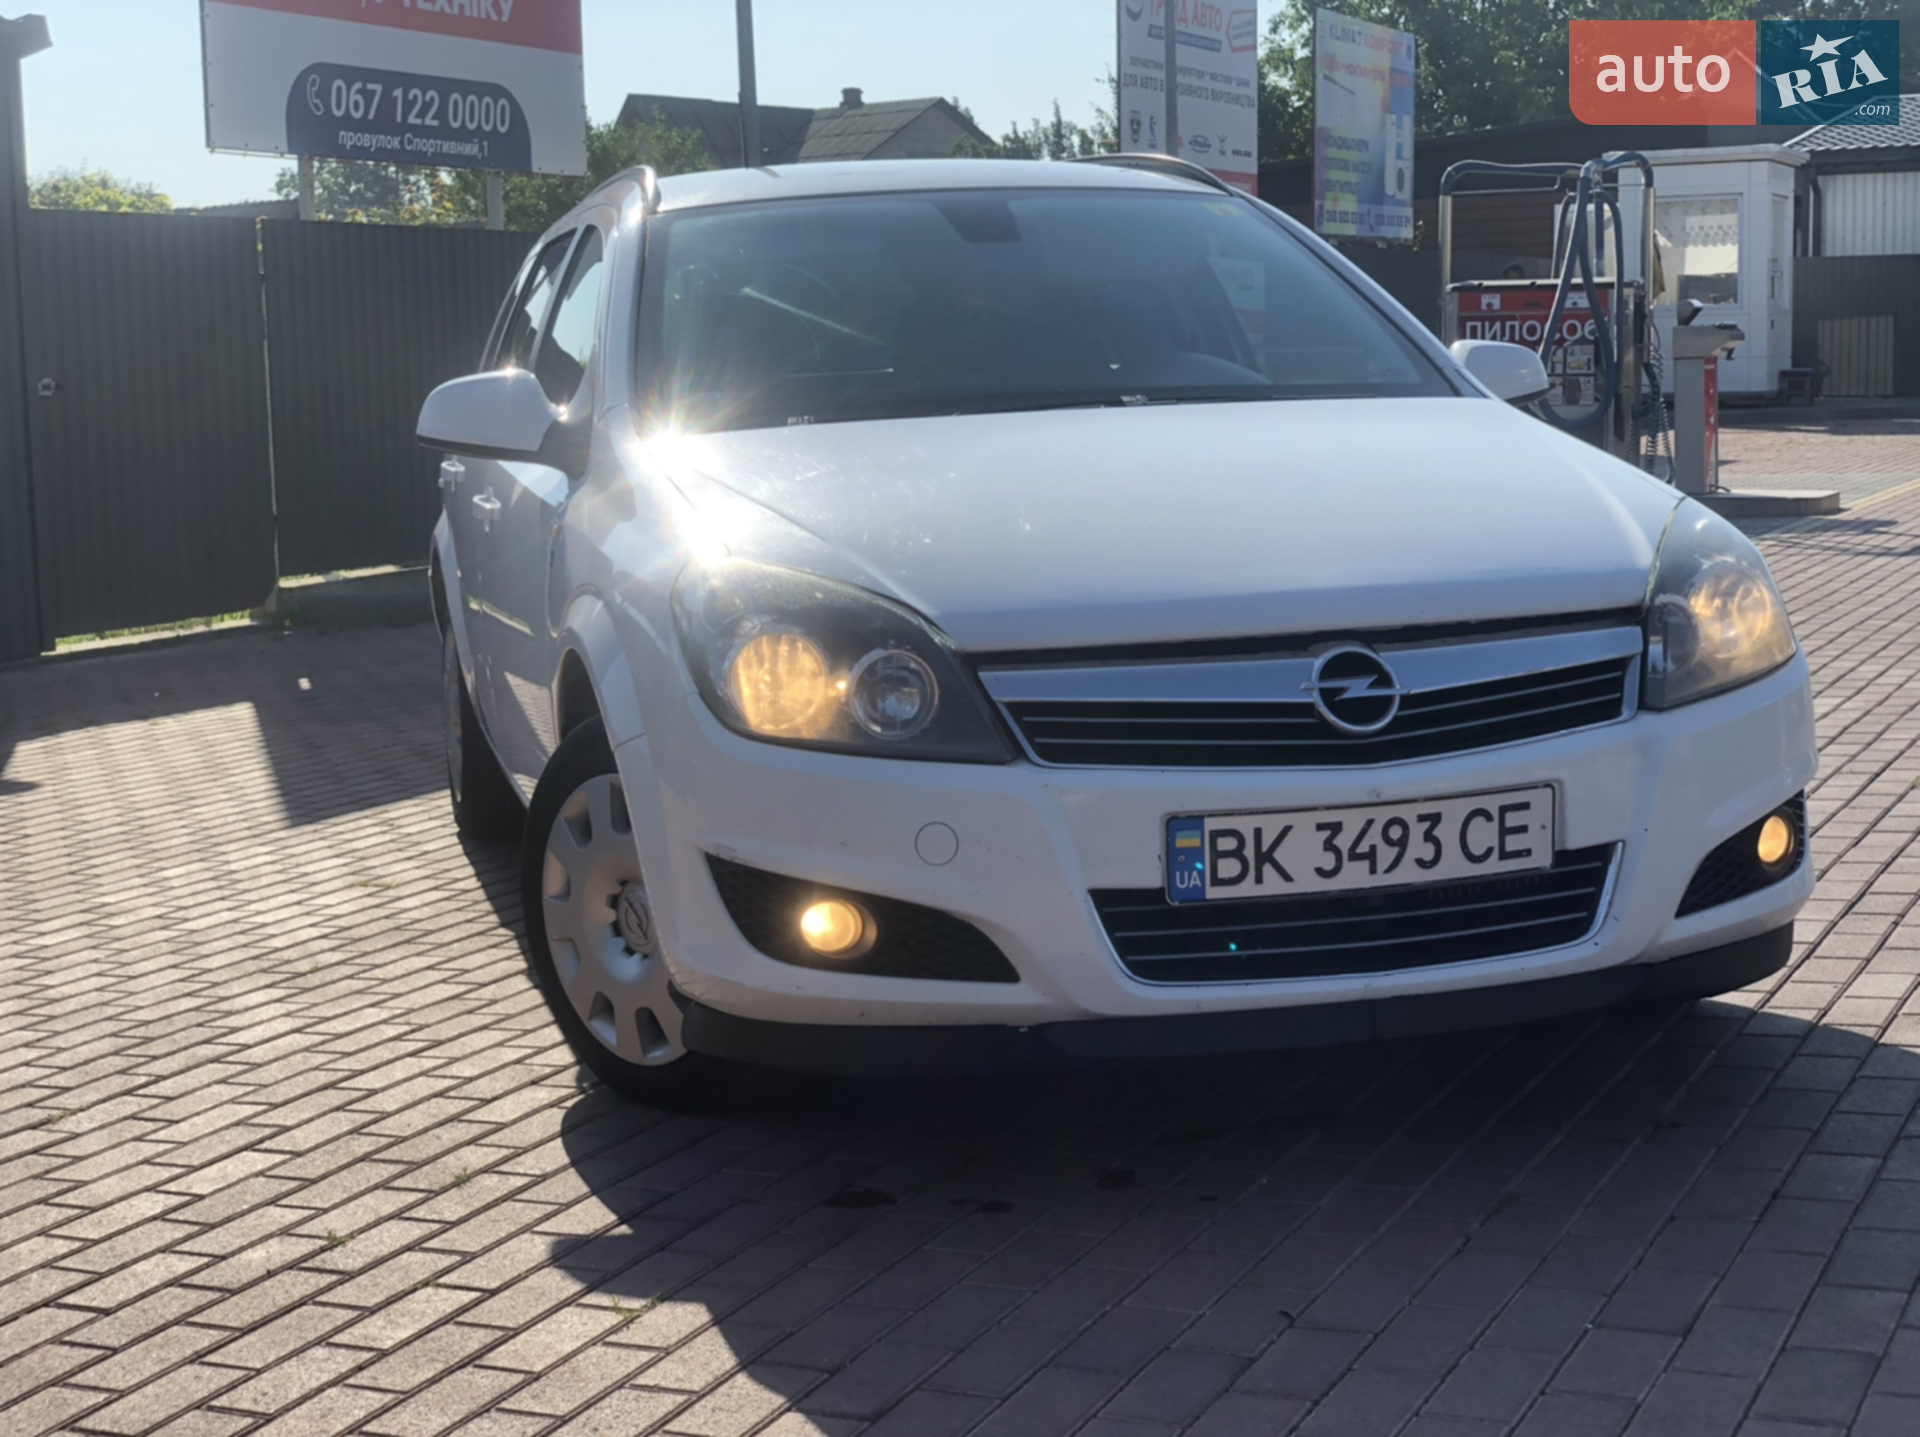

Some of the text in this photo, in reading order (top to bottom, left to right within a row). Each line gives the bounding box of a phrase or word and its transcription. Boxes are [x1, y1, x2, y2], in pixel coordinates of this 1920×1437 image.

[1191, 1, 1223, 32] АВТО
[331, 79, 511, 133] 067 122 0000
[338, 130, 401, 151] провулок
[1208, 801, 1533, 888] BK 3493 CE
[1175, 870, 1202, 890] UA
